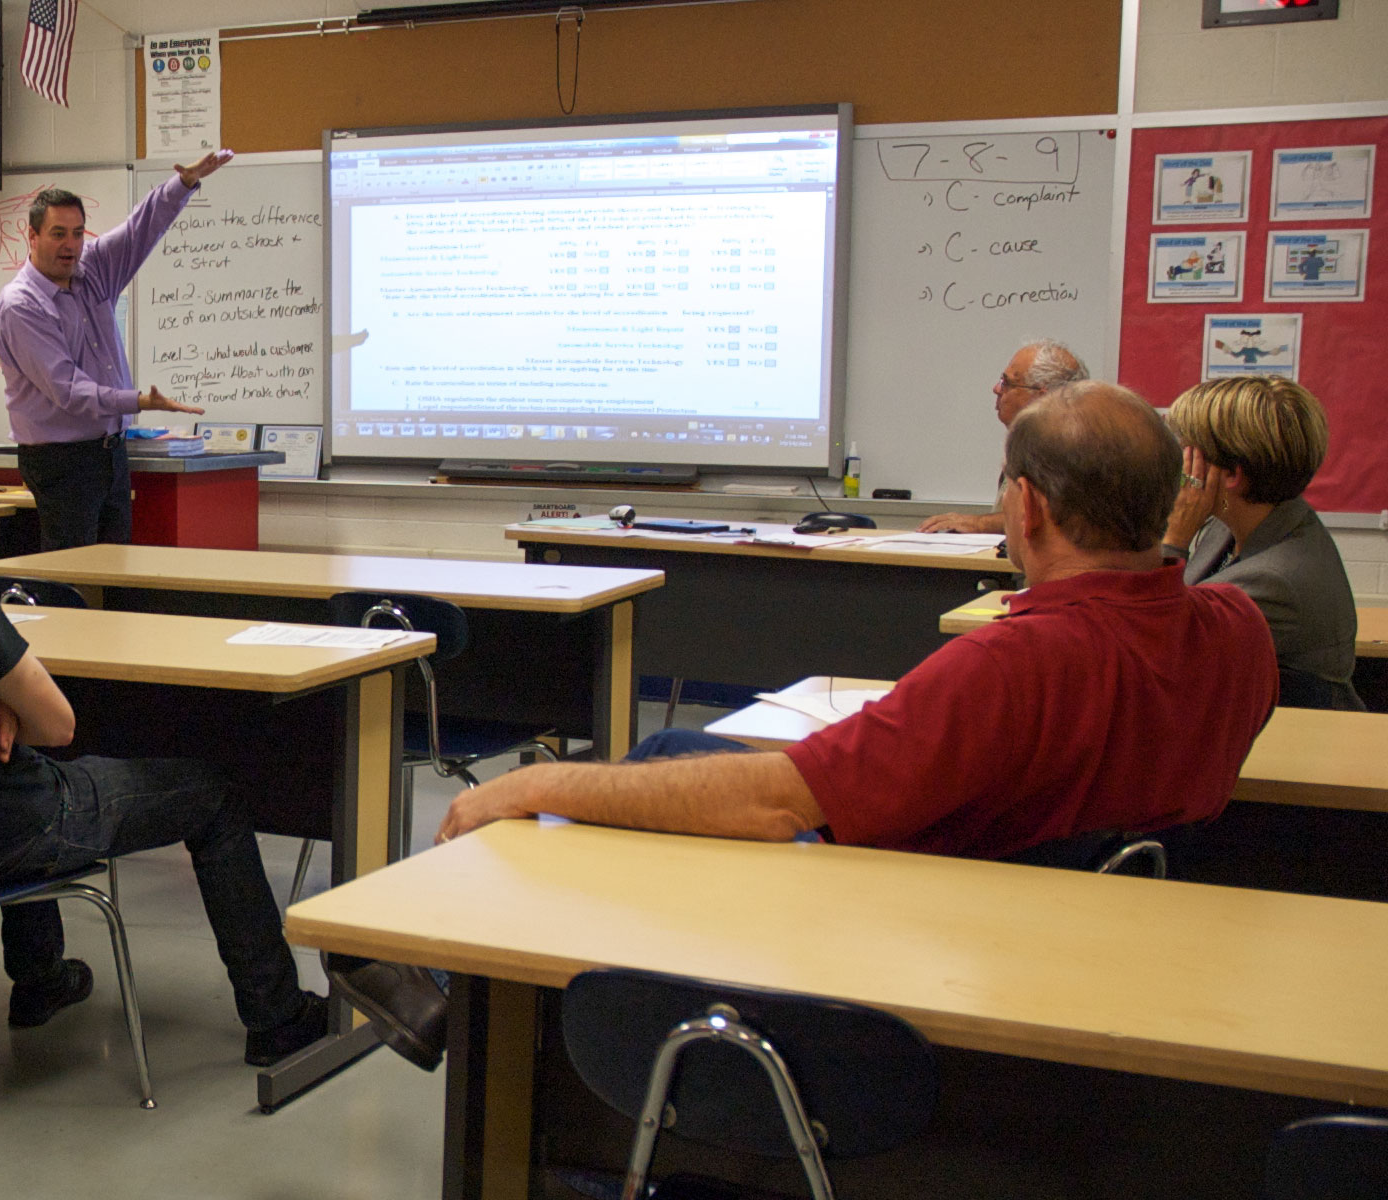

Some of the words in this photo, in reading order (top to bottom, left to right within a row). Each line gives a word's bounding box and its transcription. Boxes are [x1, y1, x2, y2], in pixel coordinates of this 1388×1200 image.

[170, 38, 211, 48] Emergency
[892, 143, 931, 177] 7
[963, 142, 995, 173] 8
[1035, 137, 1060, 172] 9
[946, 180, 969, 211] C
[994, 185, 1080, 211] complaint
[167, 216, 216, 236] xplain
[221, 209, 247, 226] the
[251, 205, 323, 226] difference
[163, 238, 225, 256] between
[230, 240, 241, 249] a
[945, 231, 963, 262] C
[989, 239, 1042, 255] cause
[173, 258, 183, 268] a
[151, 287, 178, 305] Level
[182, 282, 195, 299] 2
[281, 278, 304, 296] the
[943, 282, 965, 311] C
[982, 282, 1079, 309] correction
[158, 318, 179, 330] use
[183, 311, 194, 325] of
[199, 313, 216, 324] an
[220, 305, 266, 321] outside
[152, 346, 182, 364] Level
[184, 344, 199, 360] 3
[233, 341, 258, 358] would
[261, 348, 267, 356] a
[170, 367, 225, 388] complain
[266, 365, 295, 378] with
[298, 367, 315, 377] an
[242, 386, 273, 400] brake
[276, 382, 310, 400] drum?
